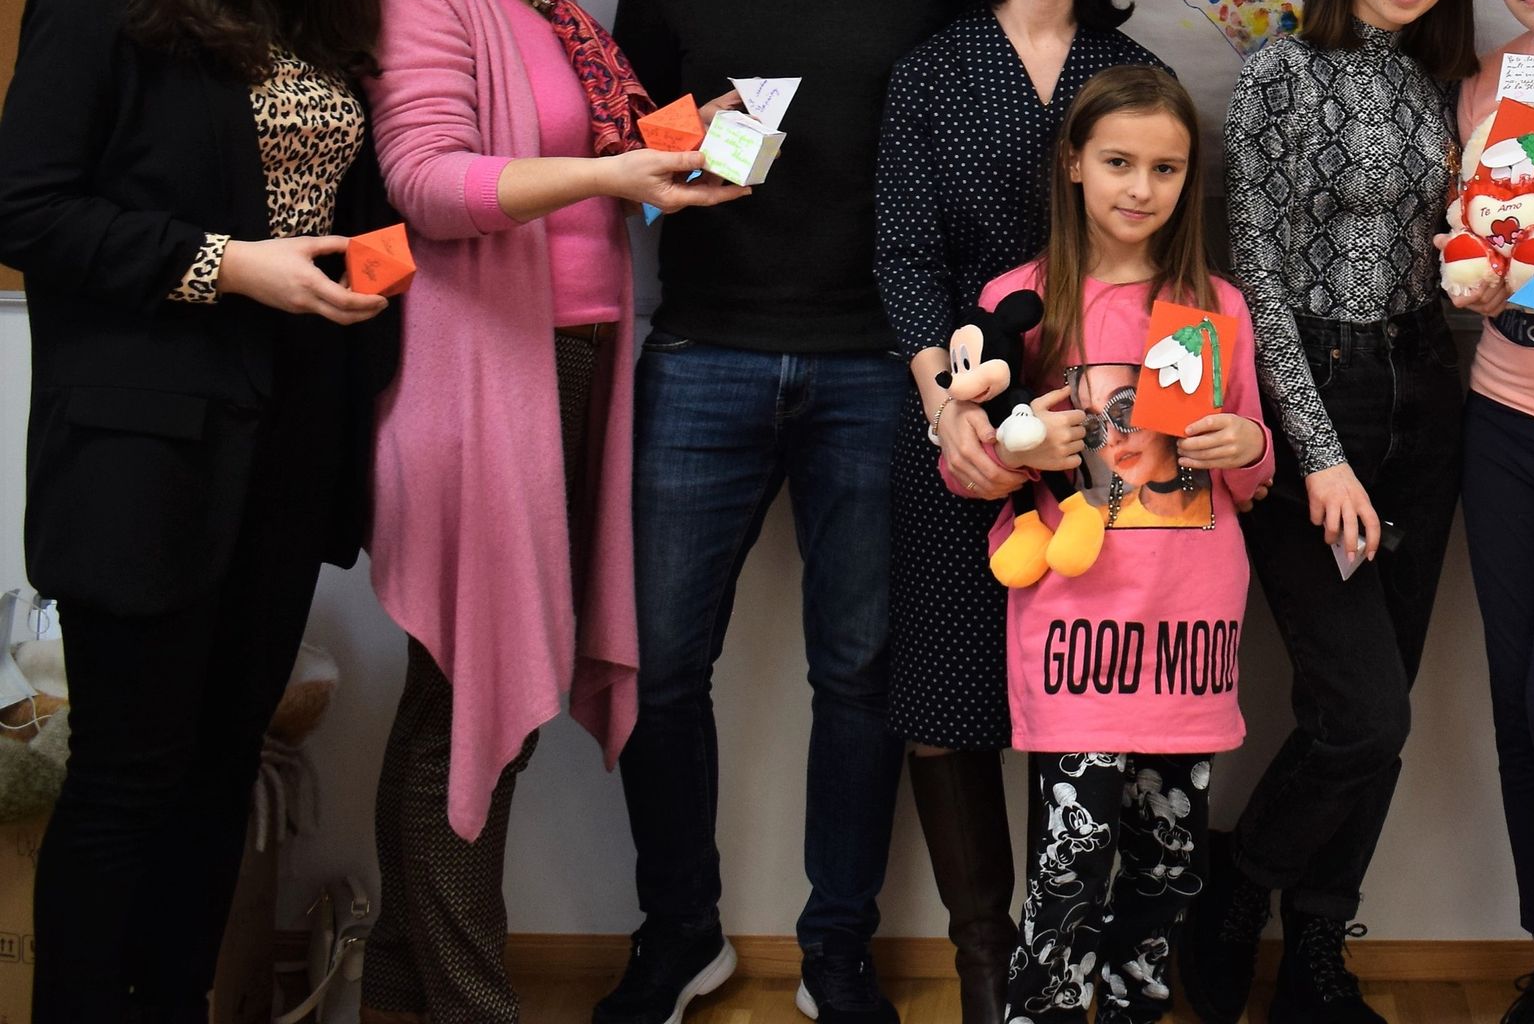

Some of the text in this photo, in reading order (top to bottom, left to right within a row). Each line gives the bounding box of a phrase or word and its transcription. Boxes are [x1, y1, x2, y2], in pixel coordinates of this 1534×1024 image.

[1480, 202, 1523, 217] Te Amo
[1043, 619, 1239, 695] GOOD MOOD
